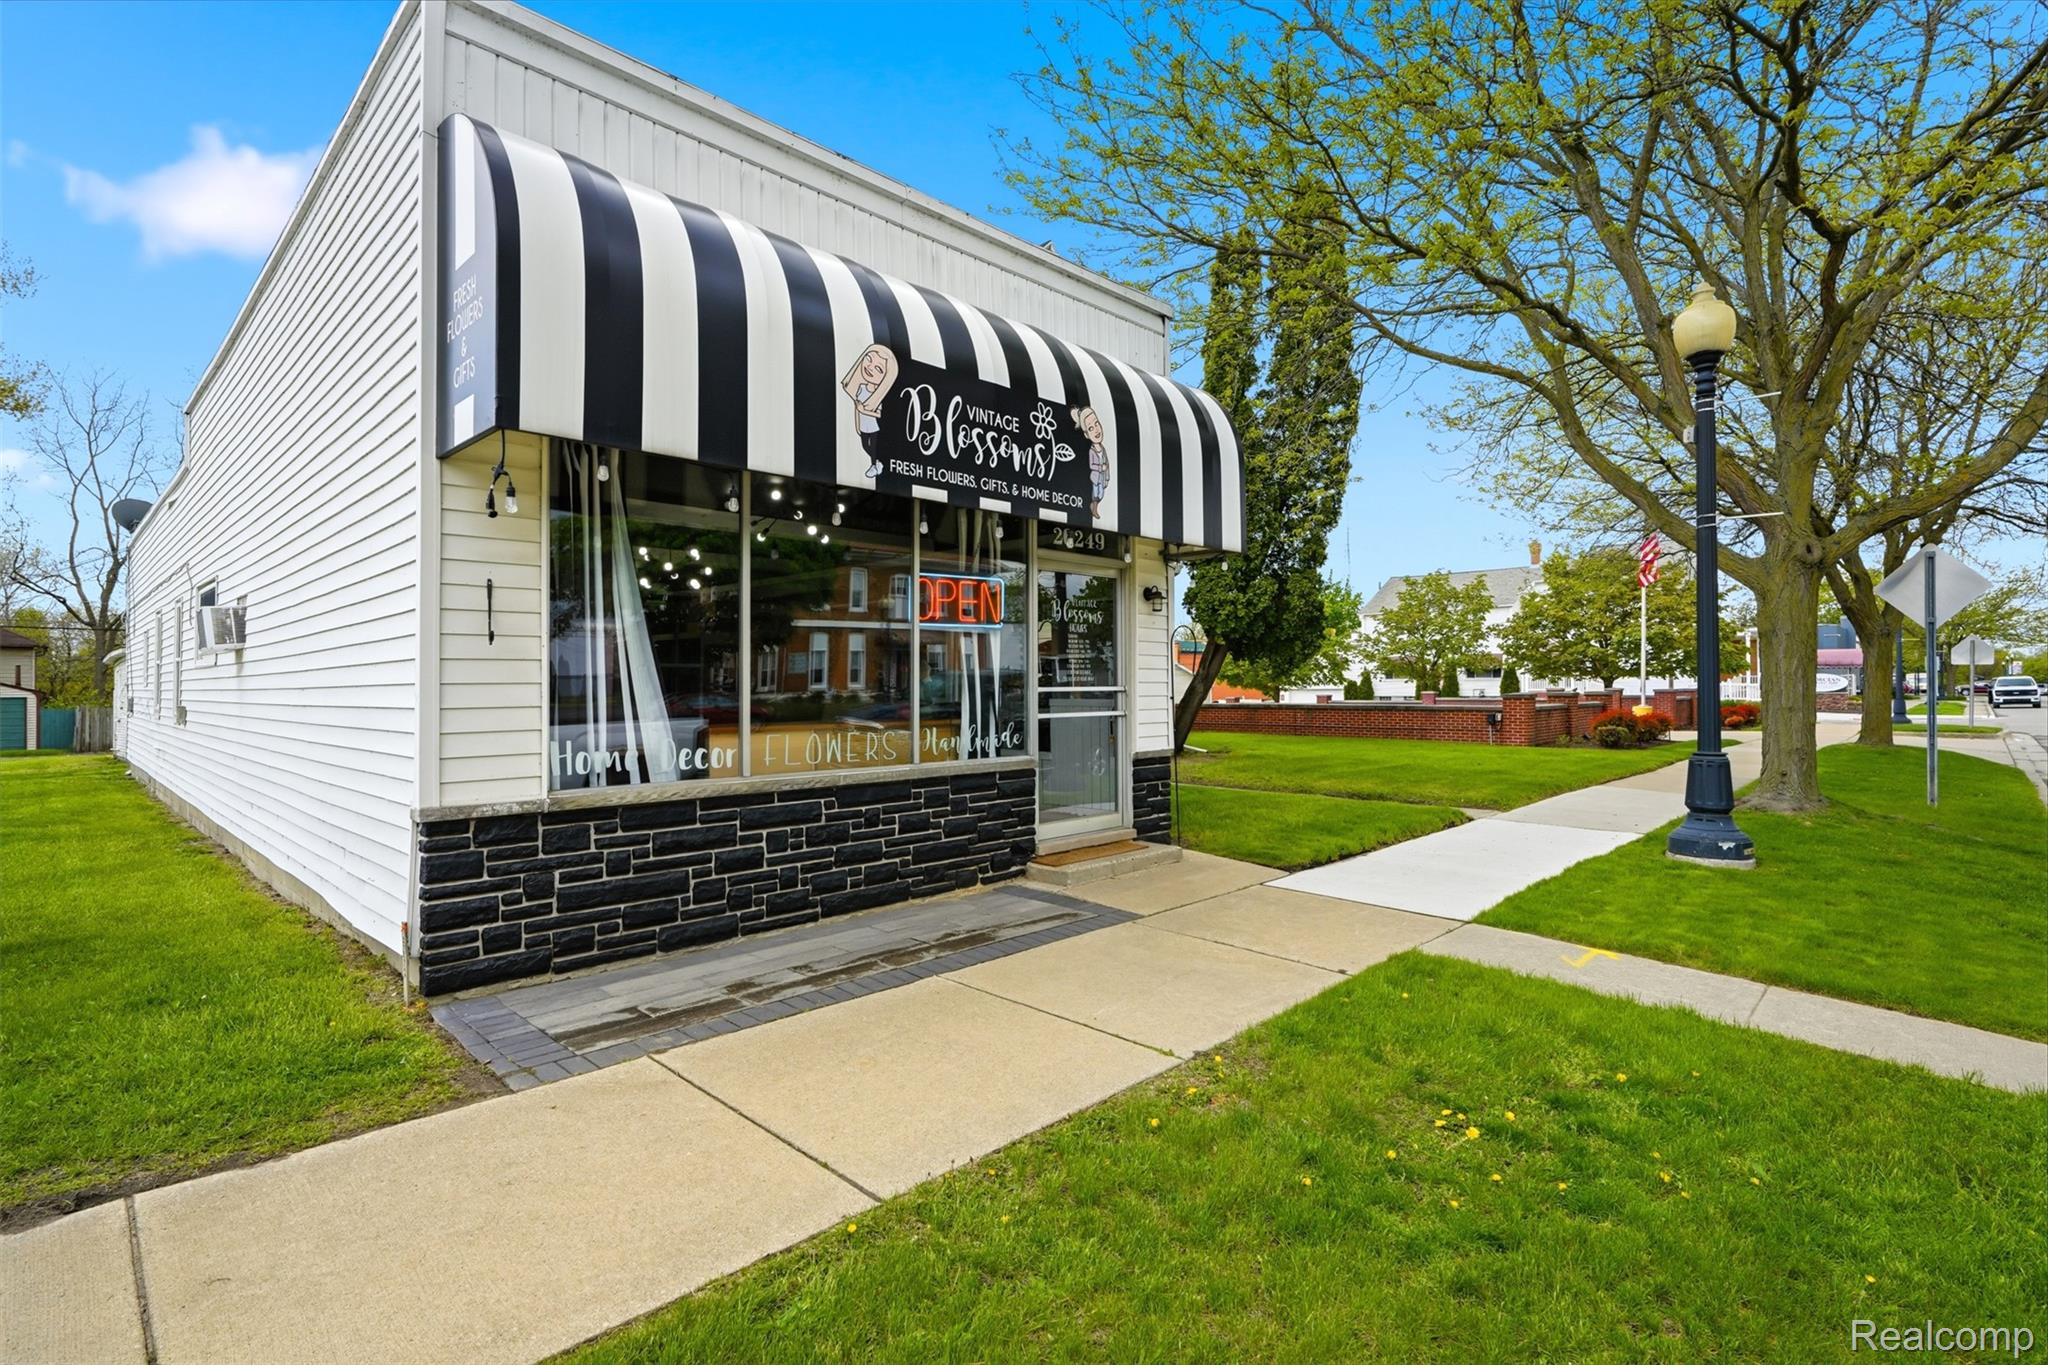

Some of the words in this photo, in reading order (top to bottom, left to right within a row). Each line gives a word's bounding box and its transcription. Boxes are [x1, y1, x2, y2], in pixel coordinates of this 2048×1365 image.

[453, 274, 476, 312] FRESH
[447, 296, 483, 343] FLOWERS
[461, 336, 468, 357] &
[453, 356, 475, 388] GIFTS
[900, 384, 1051, 479] Blossoms
[967, 404, 1020, 433] VINTAGE
[889, 459, 923, 478] FRESH
[1012, 483, 1019, 496] &
[1022, 488, 1050, 502] HOME
[1052, 492, 1083, 508] DECOR
[916, 577, 1000, 623] OPEN
[659, 738, 737, 771] Decor
[764, 731, 896, 766] FLOWERS
